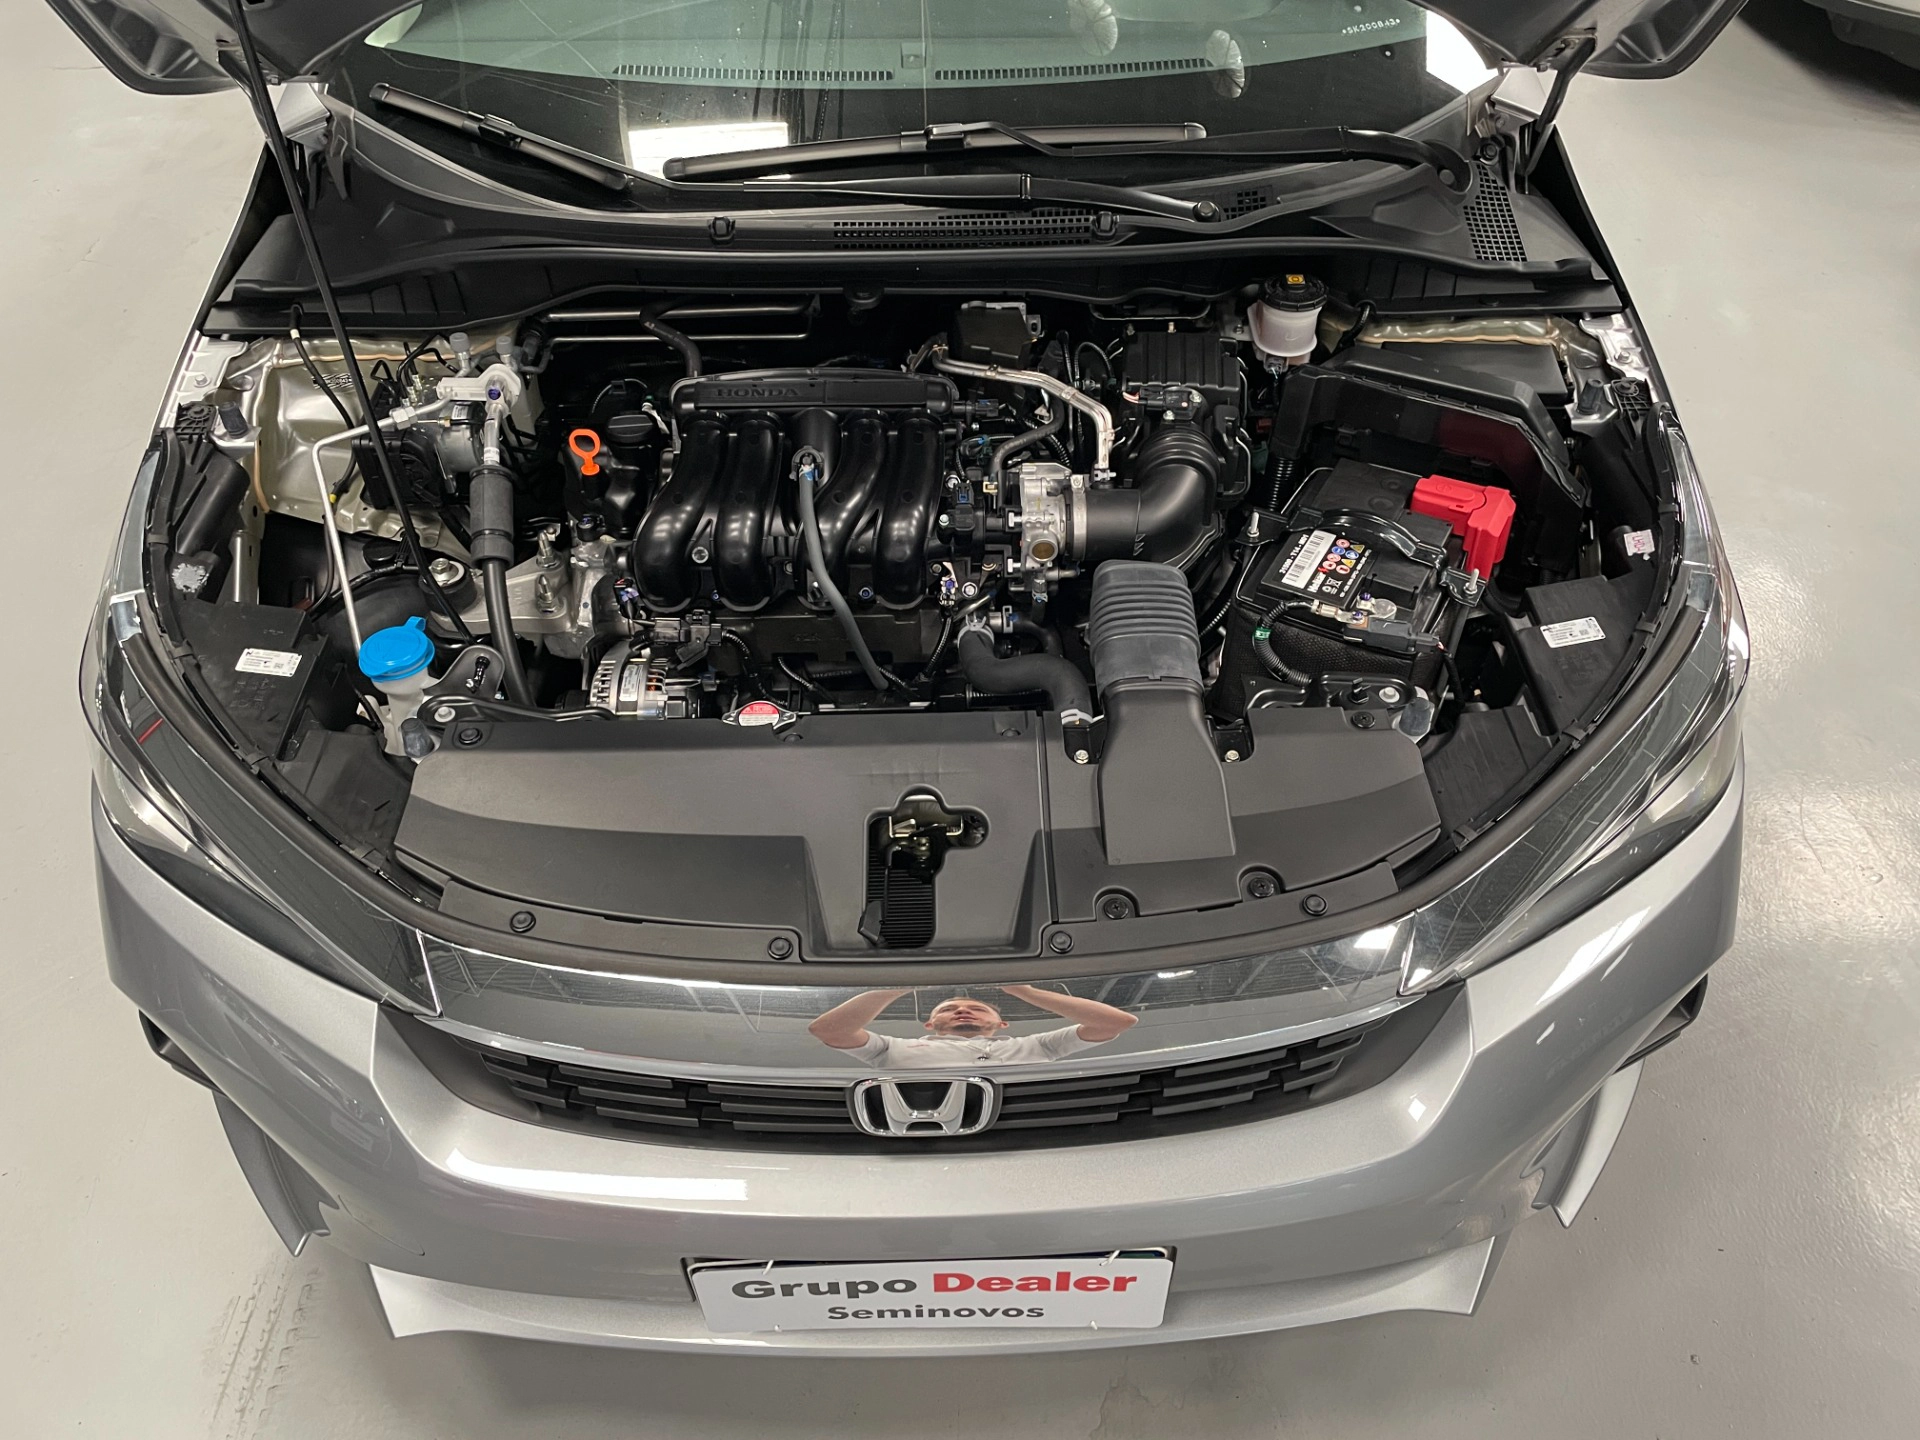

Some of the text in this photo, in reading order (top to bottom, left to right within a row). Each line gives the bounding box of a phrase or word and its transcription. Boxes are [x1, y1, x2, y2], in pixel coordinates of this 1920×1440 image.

[717, 388, 799, 397] HONDA
[731, 1271, 1138, 1299] Grupo Dealer
[827, 1303, 1045, 1320] Seminovos
